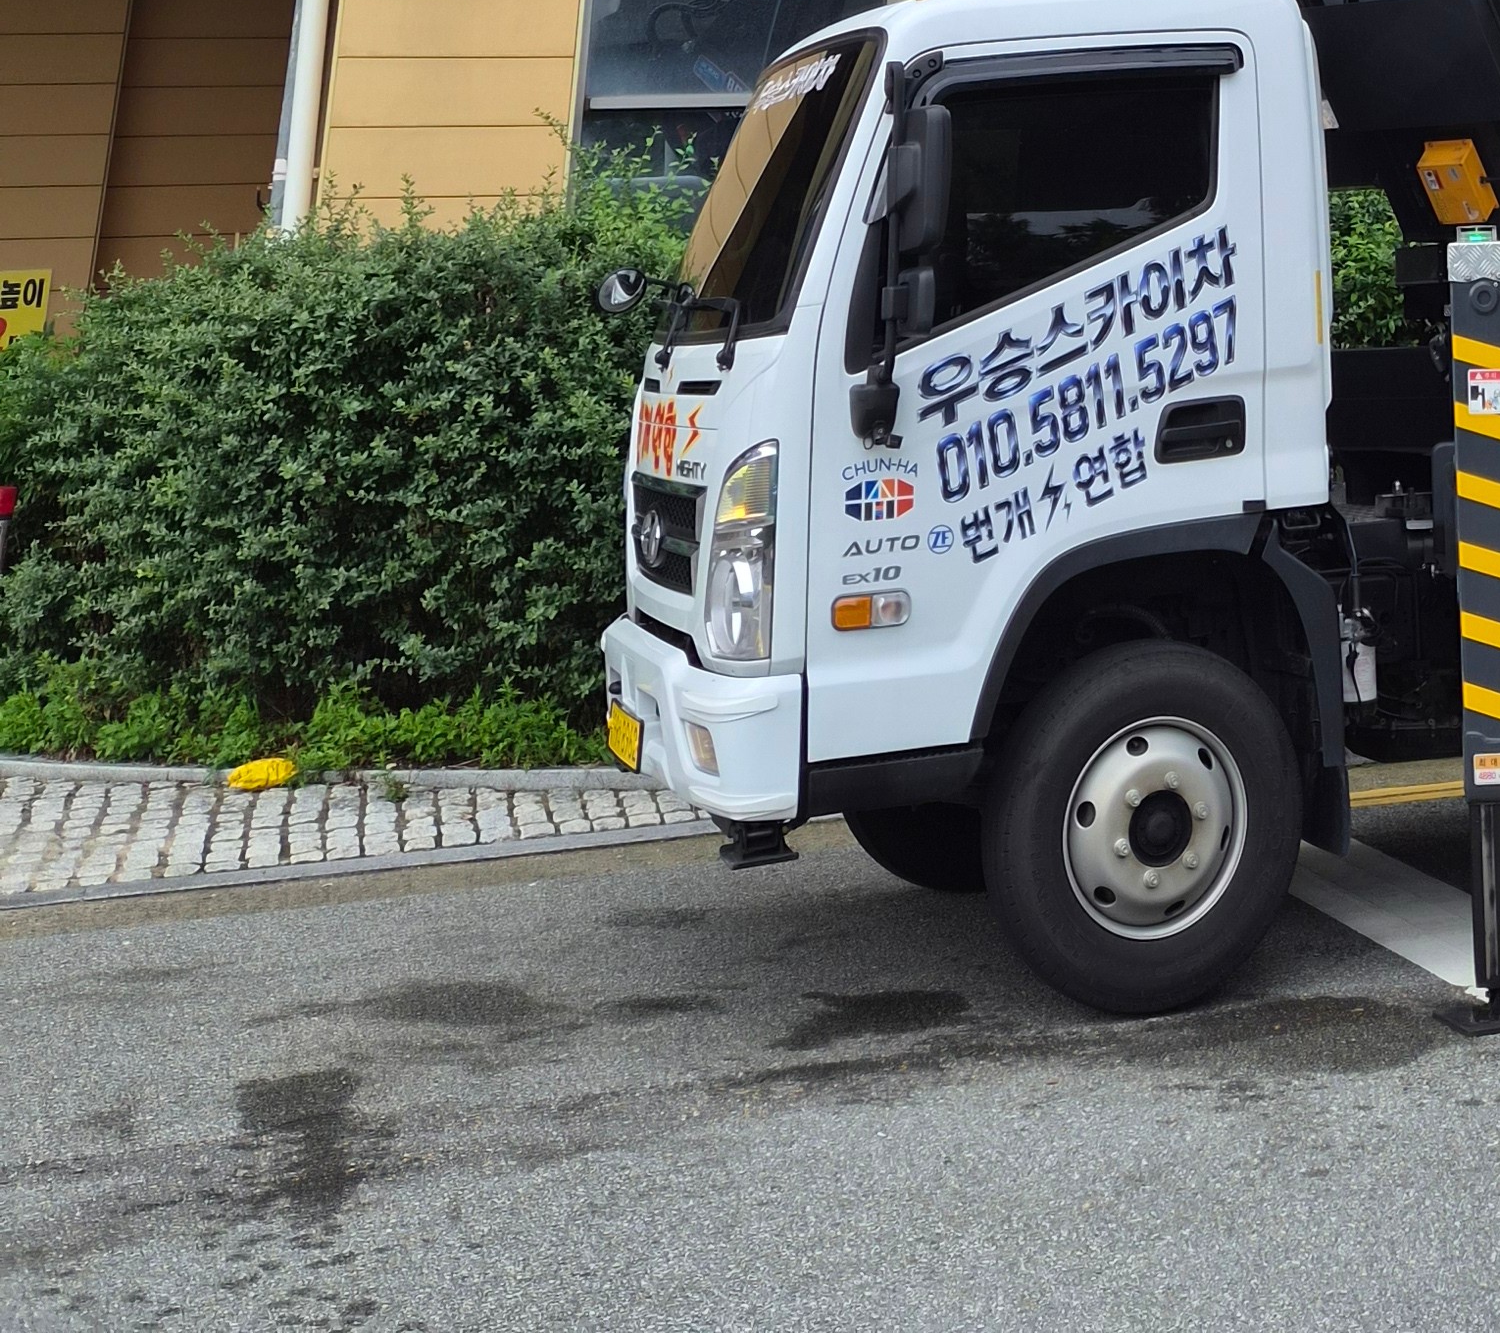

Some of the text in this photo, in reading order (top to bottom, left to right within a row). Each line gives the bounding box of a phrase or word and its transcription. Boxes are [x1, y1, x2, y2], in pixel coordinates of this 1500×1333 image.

[916, 224, 1238, 428] 우승스카이차
[936, 294, 1237, 503] 010.5811.5297
[841, 457, 919, 482] CHUN-HA
[959, 427, 1148, 564] 번개 연합
[841, 534, 921, 558] AUTO
[841, 565, 902, 585] EX10
